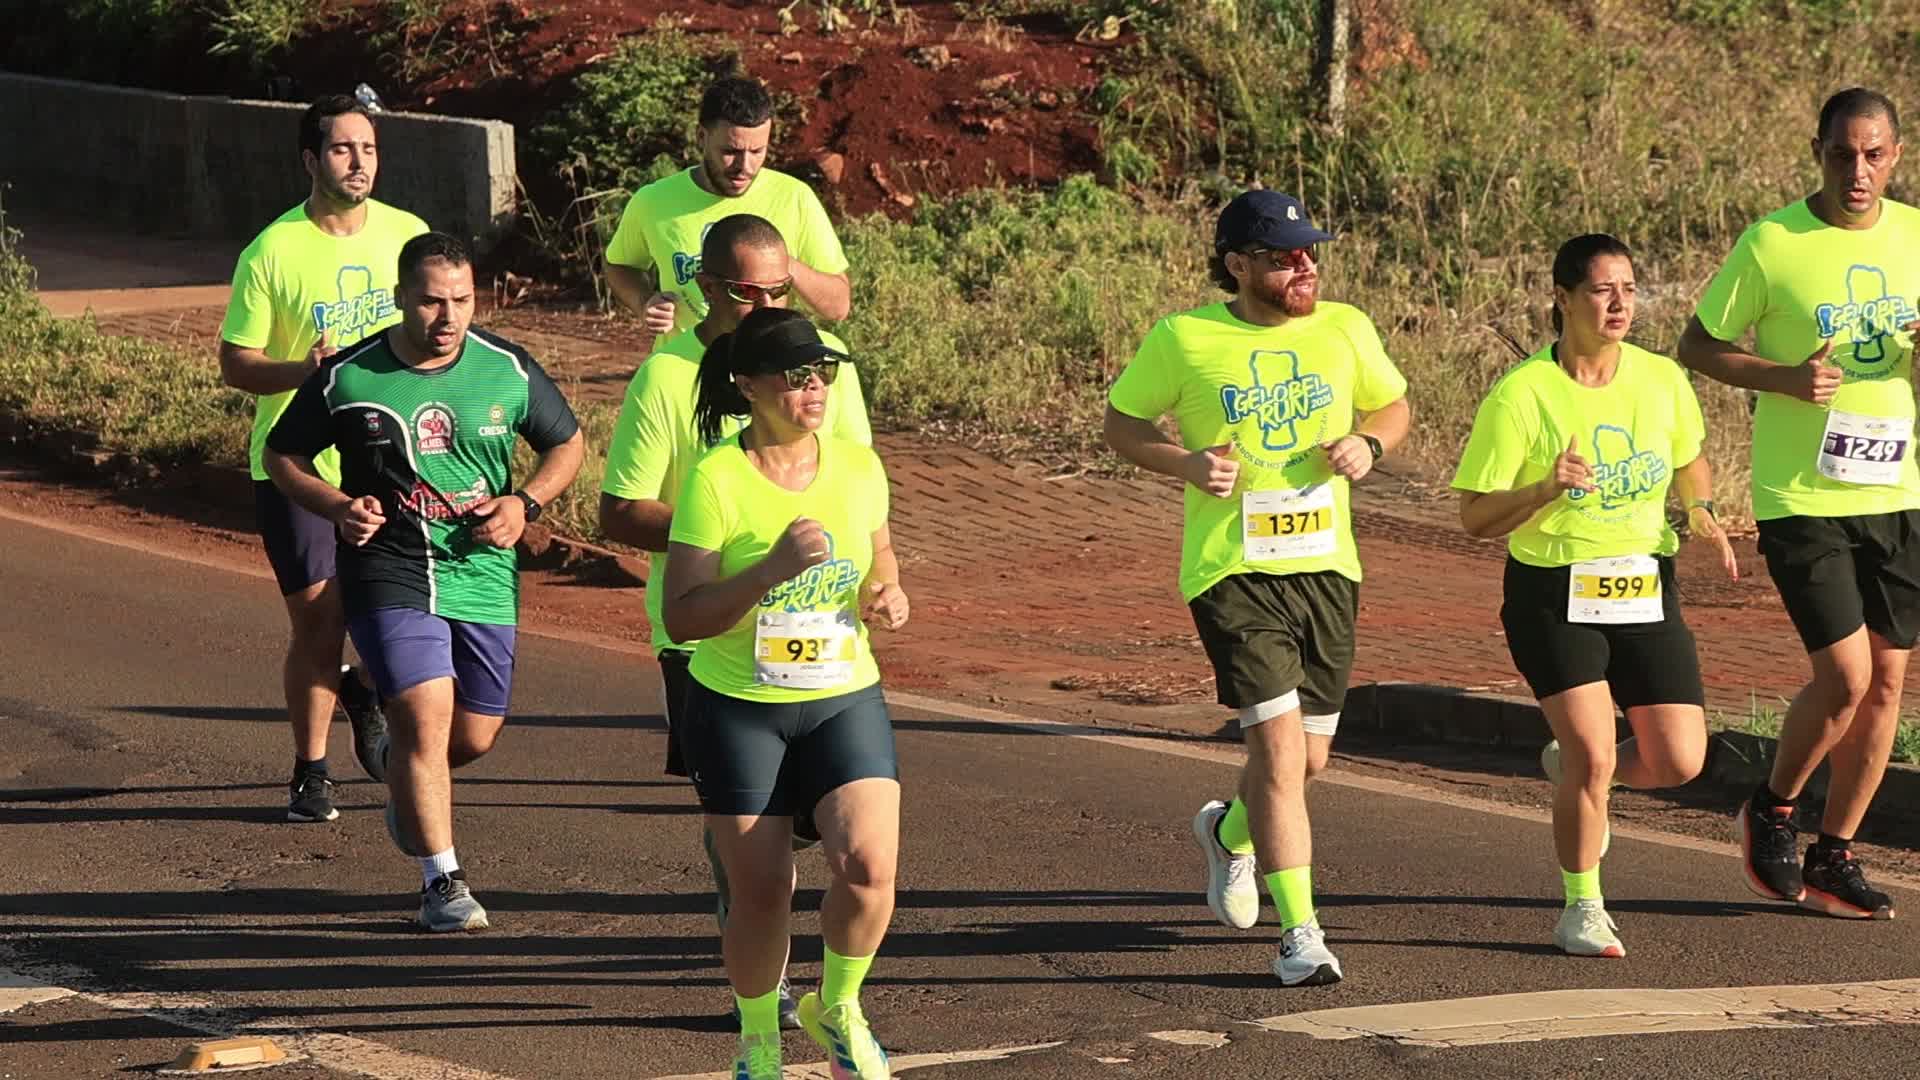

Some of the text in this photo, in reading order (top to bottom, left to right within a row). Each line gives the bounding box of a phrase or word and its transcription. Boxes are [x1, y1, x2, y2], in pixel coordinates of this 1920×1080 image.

[1257, 395, 1309, 429] RUN
[1844, 437, 1898, 461] 1249
[1594, 454, 1664, 487] ELOBEL
[1269, 510, 1320, 535] 1371
[1597, 576, 1644, 598] 599
